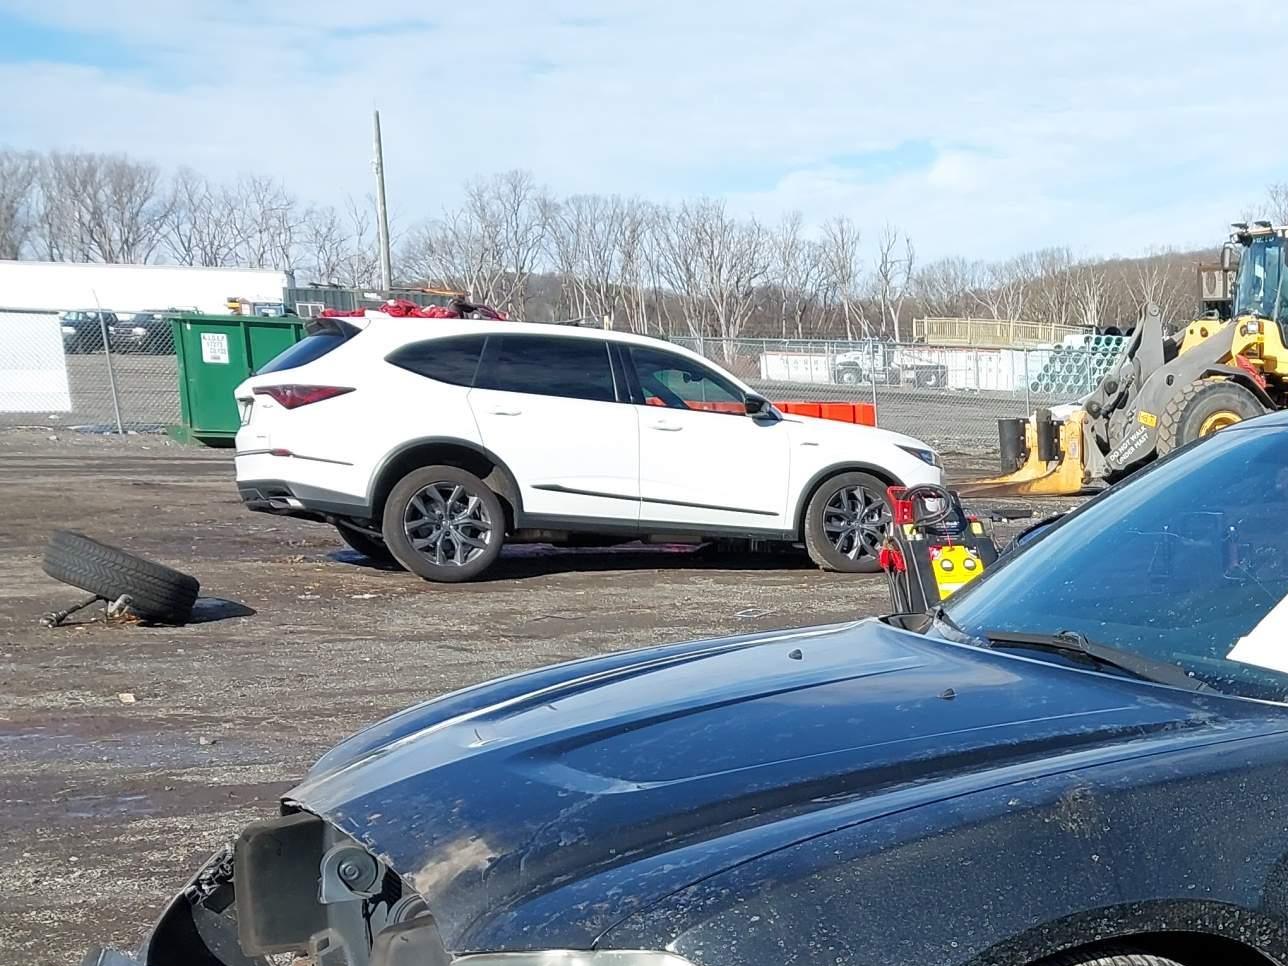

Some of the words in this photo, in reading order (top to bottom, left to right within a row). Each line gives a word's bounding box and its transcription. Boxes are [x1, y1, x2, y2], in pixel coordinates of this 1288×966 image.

[1110, 452, 1119, 462] DO
[1118, 439, 1131, 453] NOT
[1130, 425, 1147, 441] WALK
[1116, 446, 1136, 465] UNDER
[1134, 432, 1149, 449] MAST
